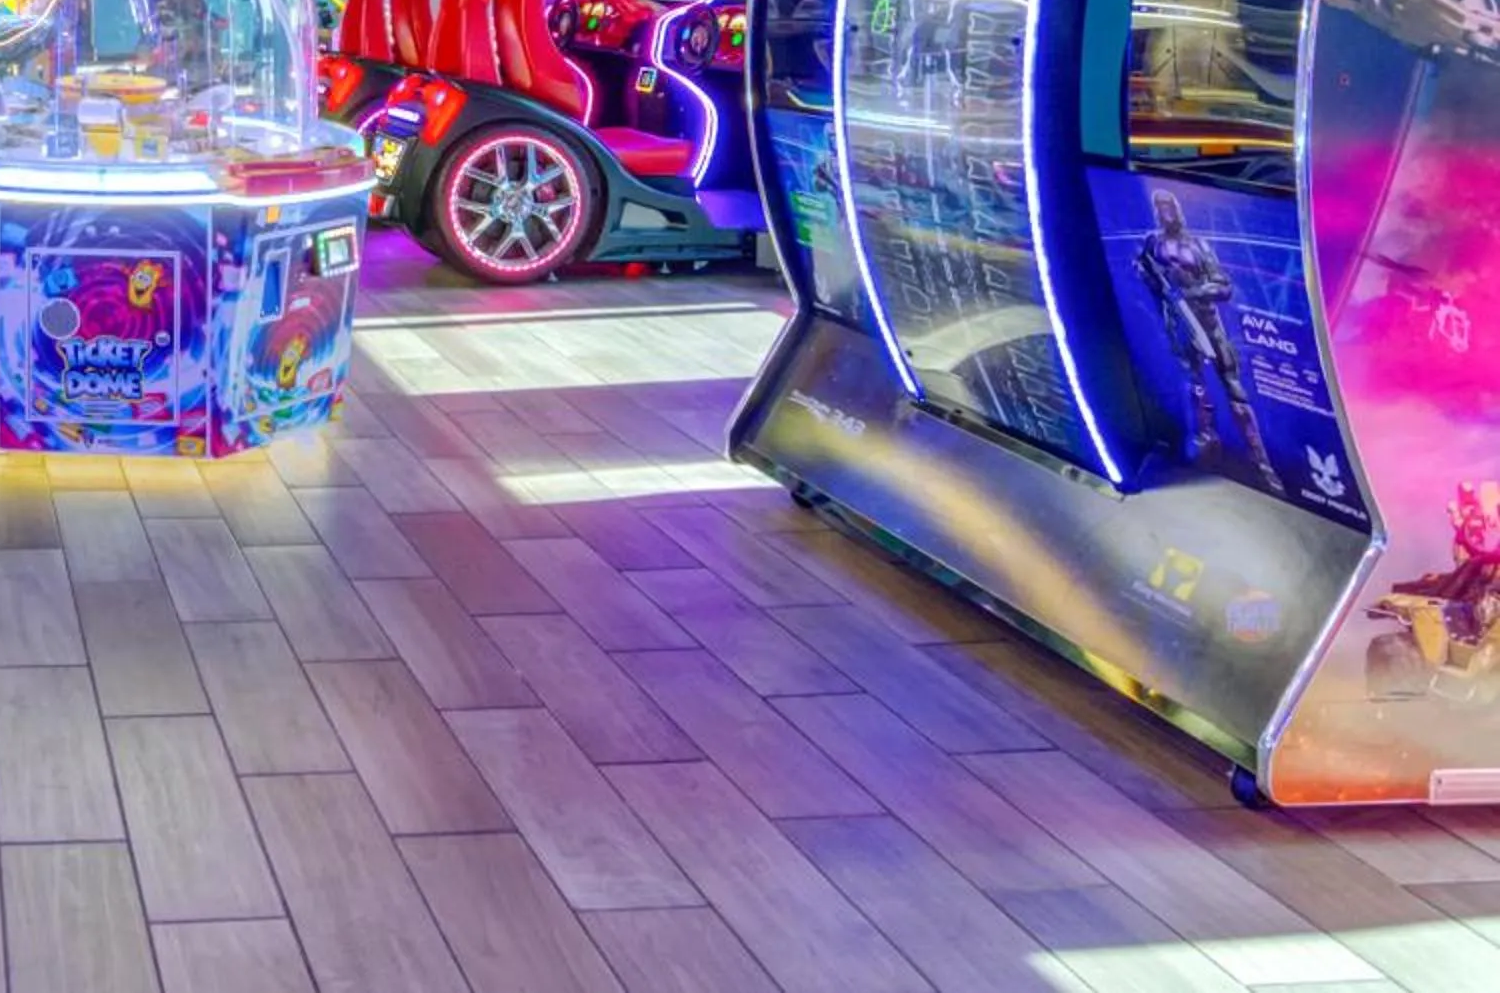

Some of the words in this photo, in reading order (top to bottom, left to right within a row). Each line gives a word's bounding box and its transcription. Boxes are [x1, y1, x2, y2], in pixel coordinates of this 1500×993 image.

[1242, 313, 1279, 335] AVA
[61, 337, 151, 368] TICKET
[1244, 329, 1299, 356] LANG
[66, 369, 143, 400] DOME
